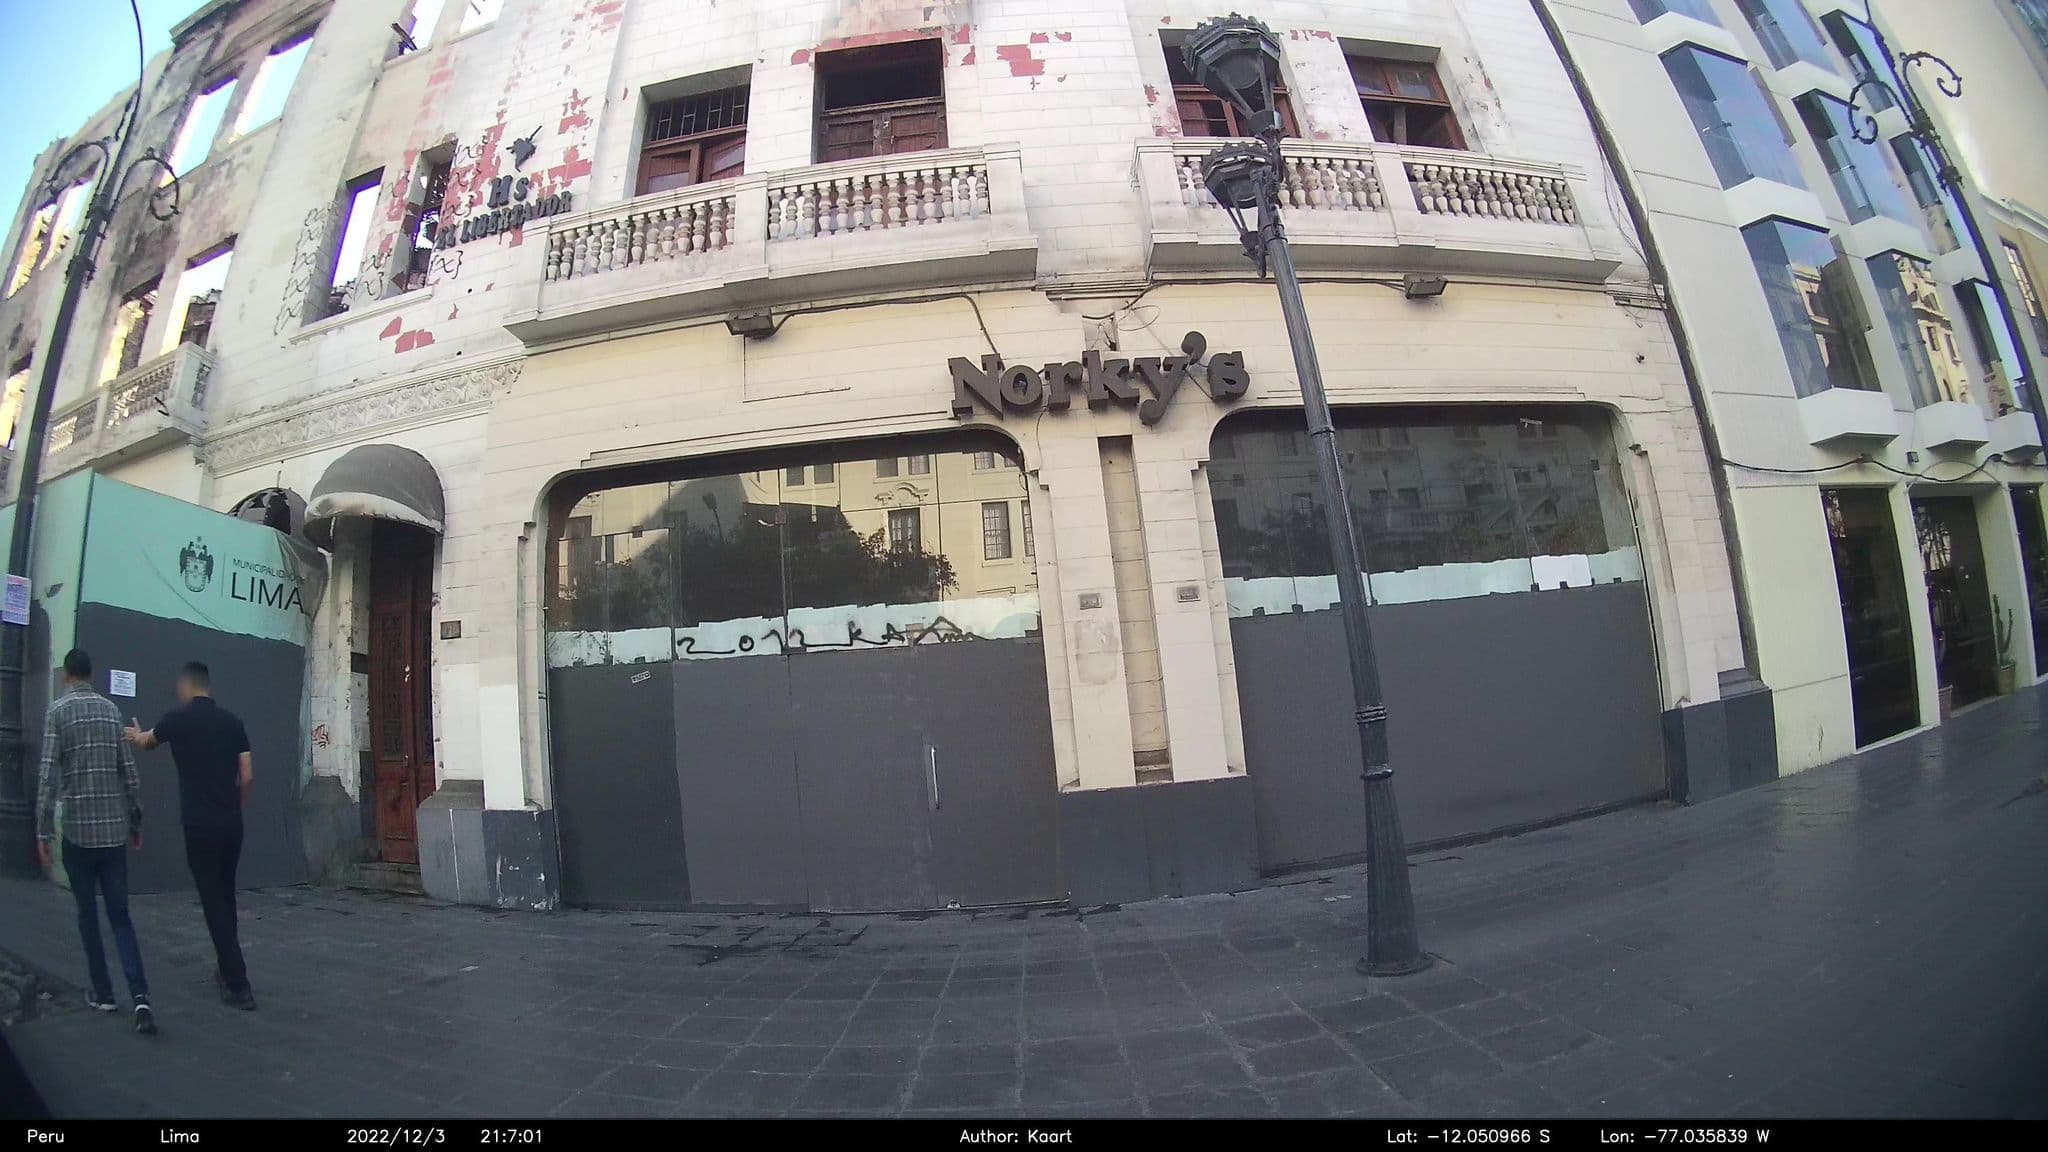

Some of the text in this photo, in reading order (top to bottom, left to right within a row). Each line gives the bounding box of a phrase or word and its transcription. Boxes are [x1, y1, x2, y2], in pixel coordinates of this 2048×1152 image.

[461, 190, 572, 243] LIBERTADOR
[948, 331, 1250, 426] Norky's
[231, 572, 305, 614] LIMA
